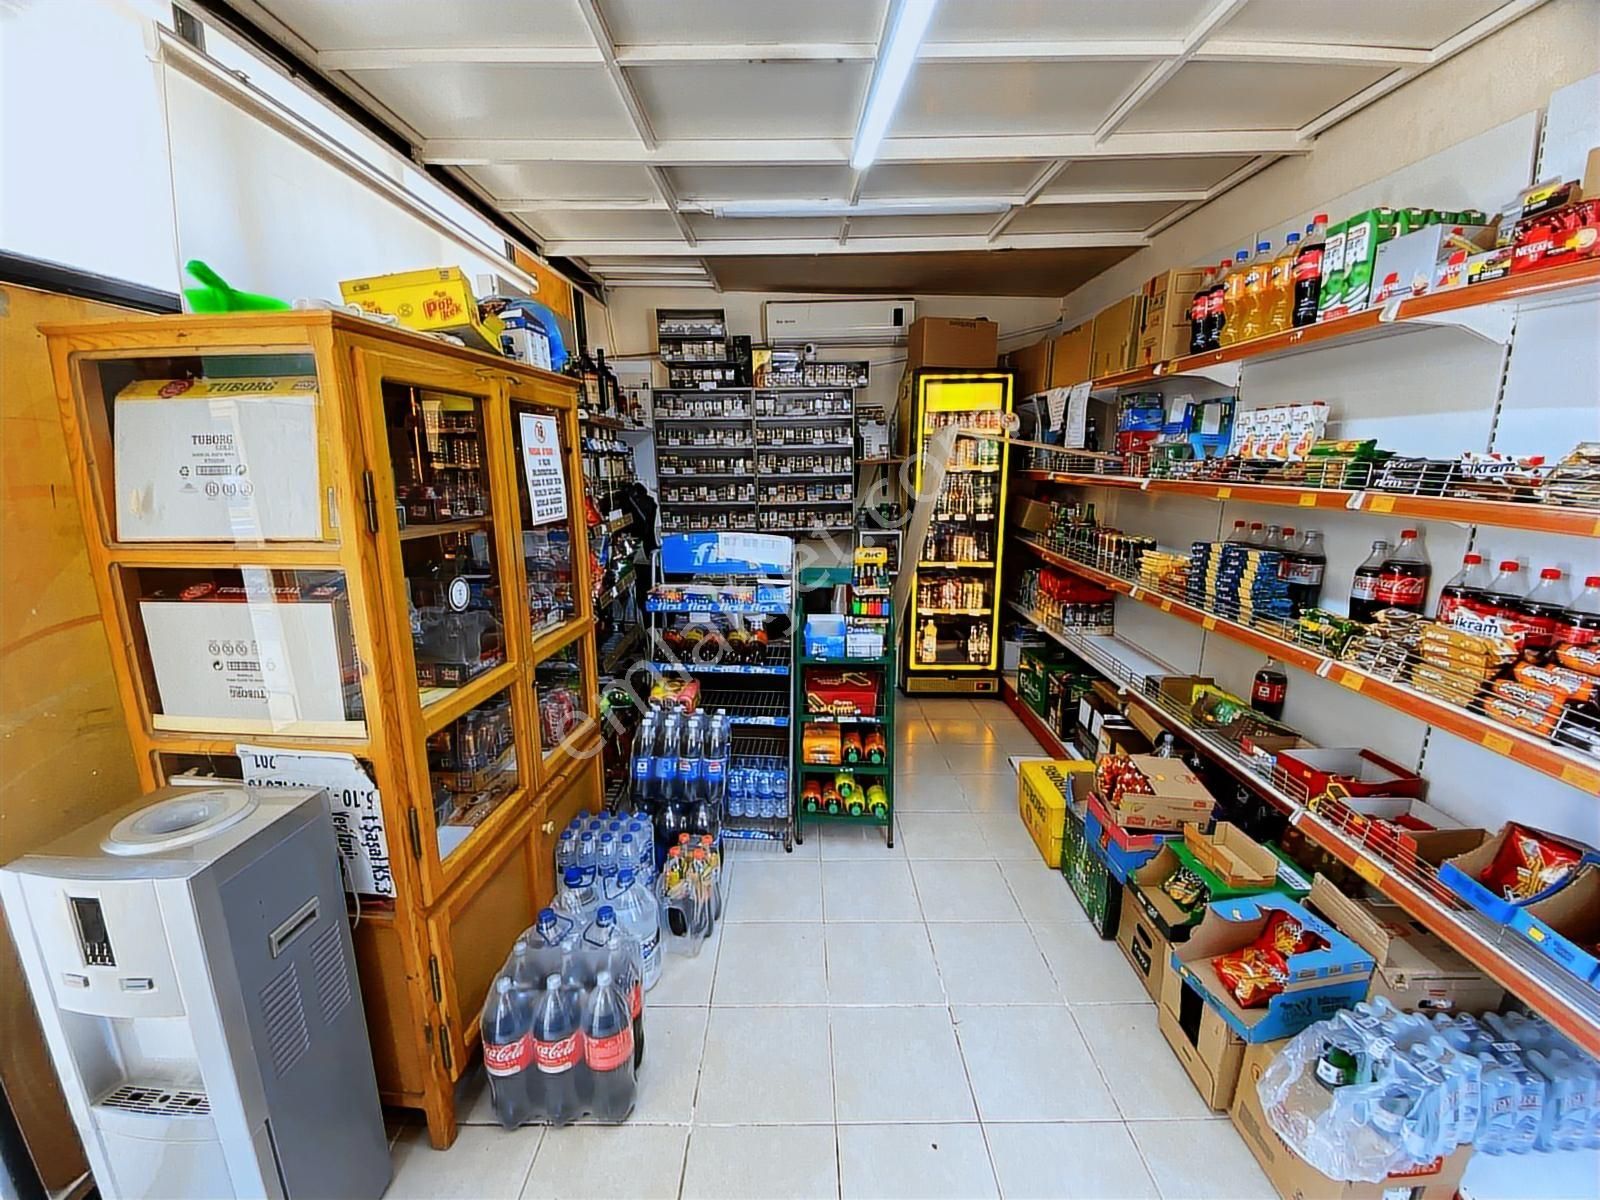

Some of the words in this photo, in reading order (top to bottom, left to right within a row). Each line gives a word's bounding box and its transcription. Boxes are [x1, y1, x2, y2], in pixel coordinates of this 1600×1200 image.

[207, 381, 278, 392] TUBORG
[192, 434, 233, 445] TUBORG
[1455, 616, 1498, 634] ikram
